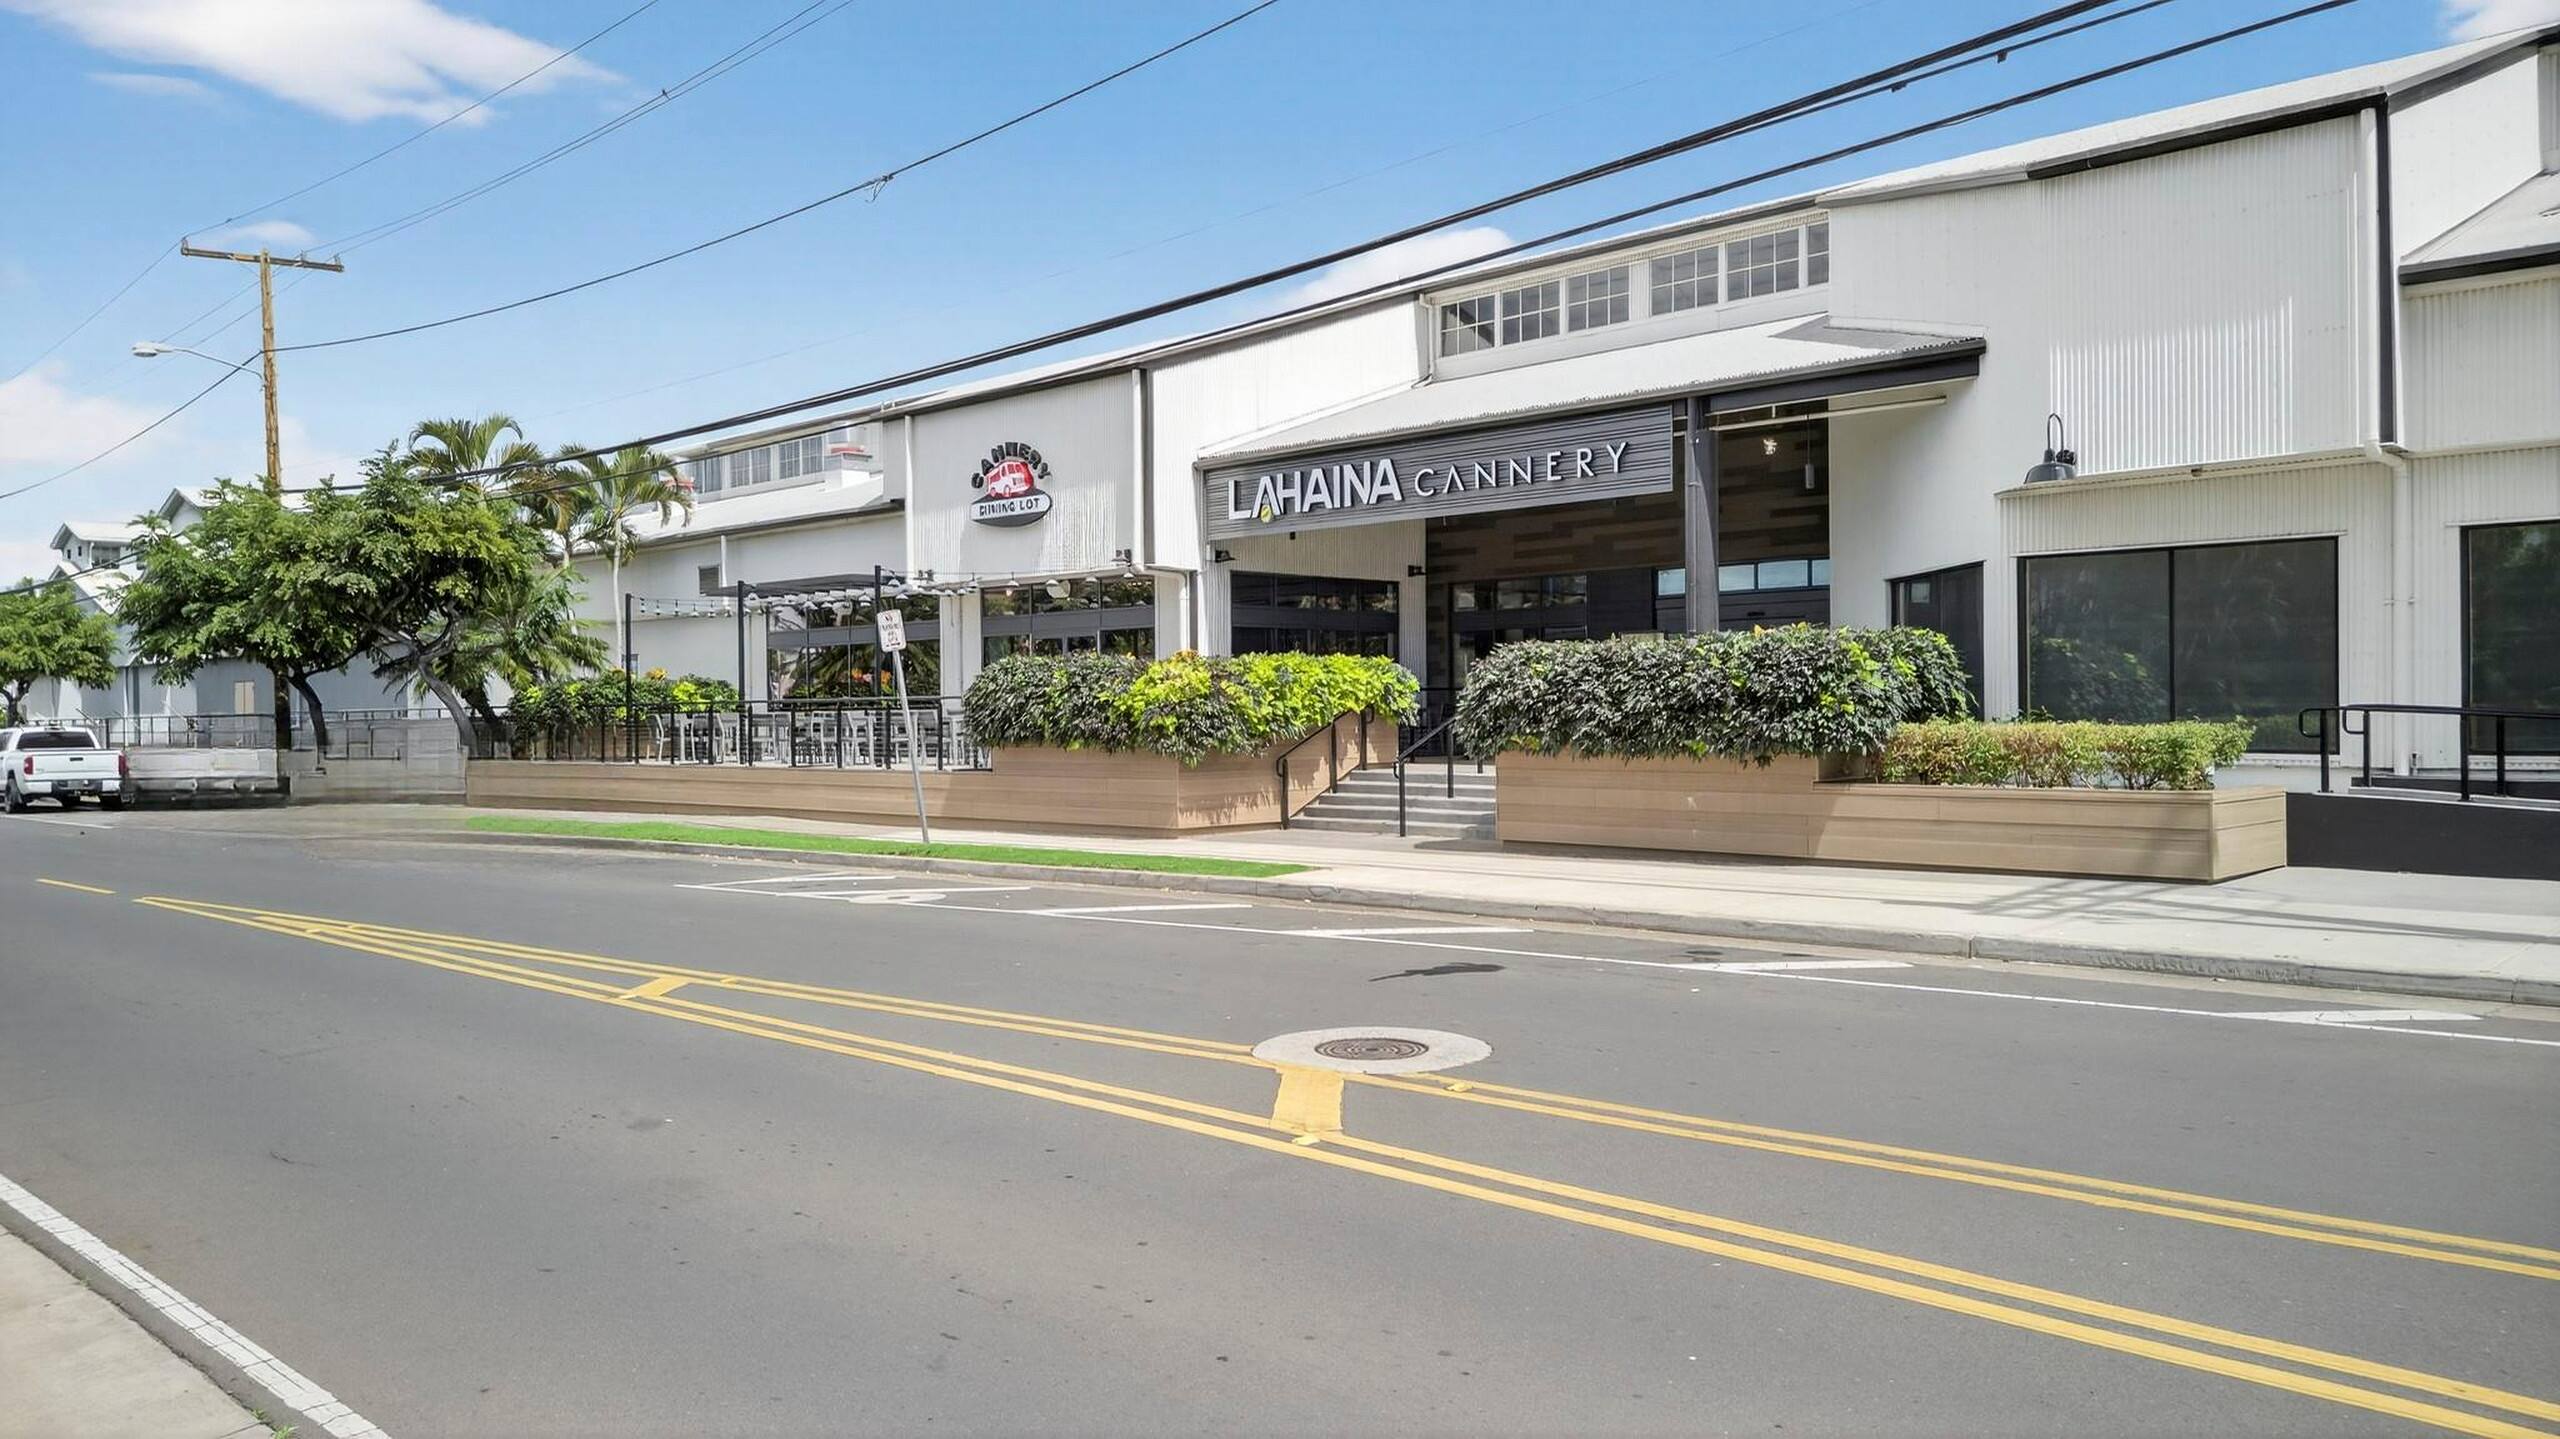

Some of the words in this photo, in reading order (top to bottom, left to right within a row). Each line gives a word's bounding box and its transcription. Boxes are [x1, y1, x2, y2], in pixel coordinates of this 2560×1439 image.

[971, 441, 1051, 488] CANNERY
[1228, 458, 1403, 521] LAHAINA
[1414, 442, 1628, 497] CANNERY
[979, 501, 1016, 516] DINING
[1019, 498, 1040, 511] LOT
